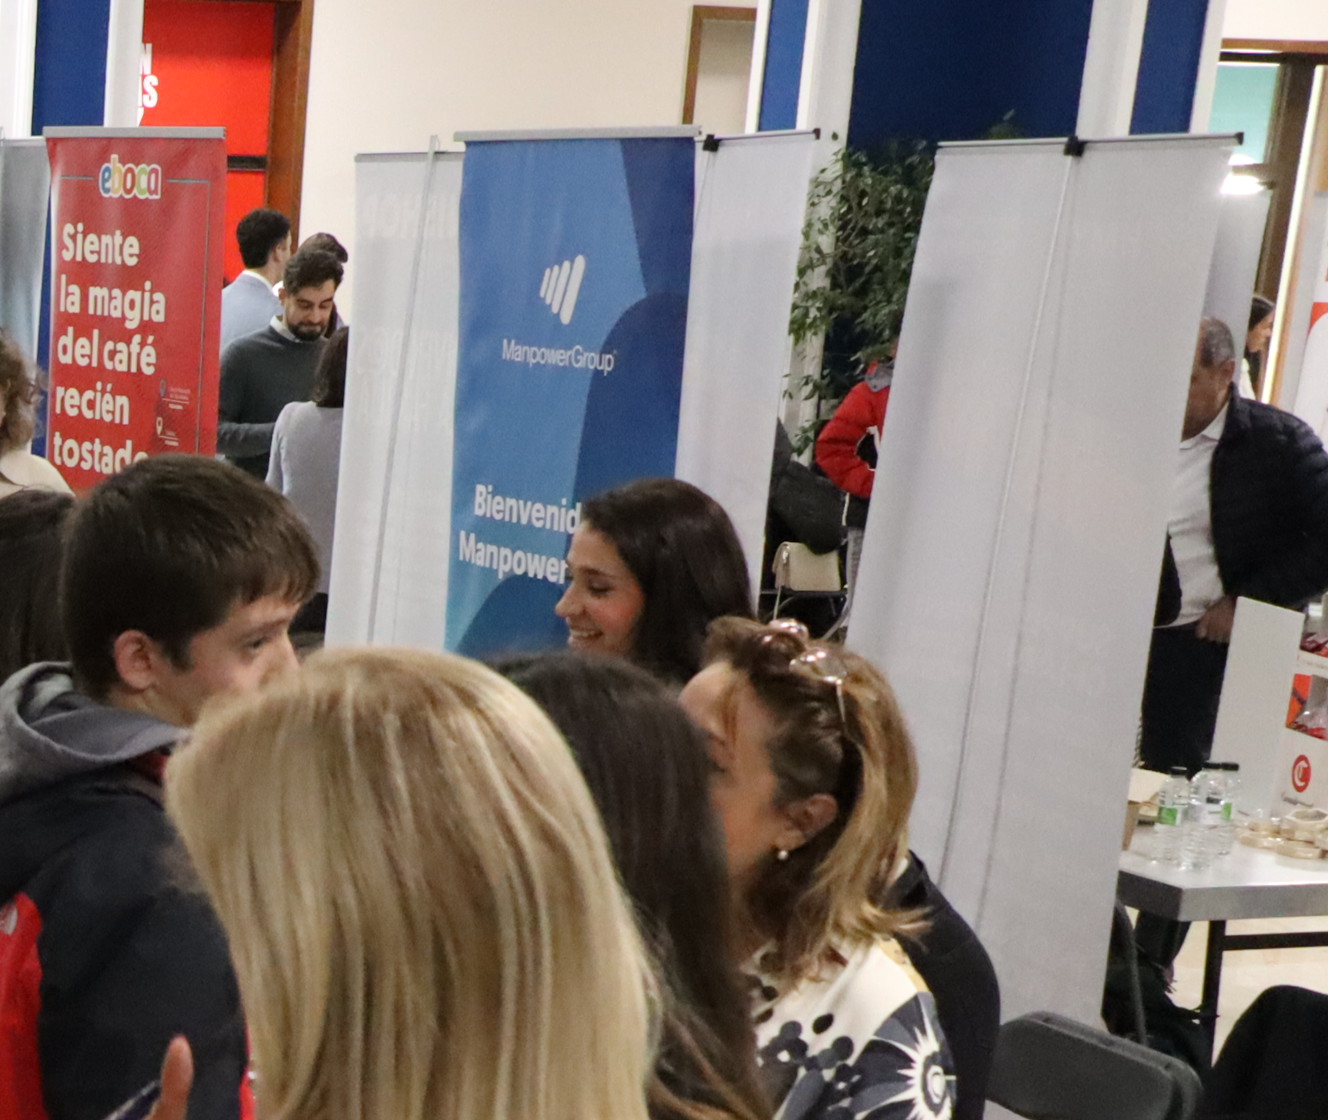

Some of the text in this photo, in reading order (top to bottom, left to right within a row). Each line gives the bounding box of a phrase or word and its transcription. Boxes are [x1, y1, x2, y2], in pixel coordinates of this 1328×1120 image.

[99, 154, 162, 200] eboca
[61, 222, 140, 266] Siente
[59, 274, 167, 330] la magia
[57, 326, 158, 376] del café
[502, 338, 615, 376] ManpowerGroup
[54, 380, 130, 426] recién
[459, 530, 569, 584] Manpower
